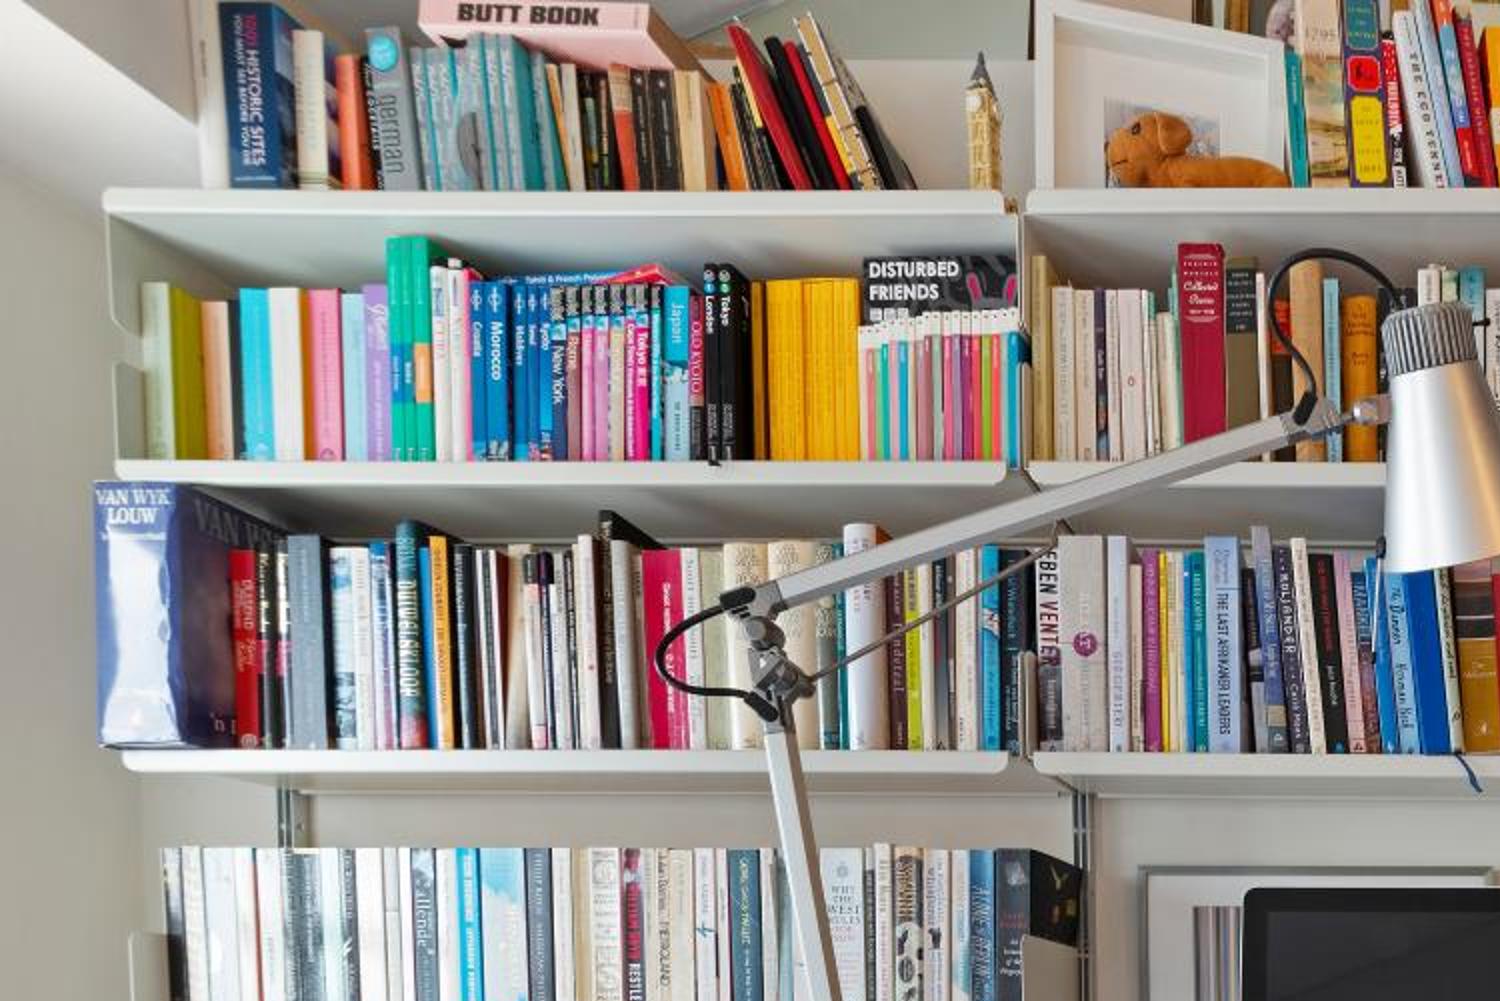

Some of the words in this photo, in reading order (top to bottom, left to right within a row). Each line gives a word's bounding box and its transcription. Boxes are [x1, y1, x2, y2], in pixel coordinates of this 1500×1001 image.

[233, 15, 243, 35] YOU
[245, 15, 259, 46] 1001
[457, 4, 522, 22] BUTT
[530, 4, 599, 25] BOOK
[235, 38, 245, 65] MUST
[237, 69, 247, 86] SEE
[245, 50, 264, 123] HISTORIC
[238, 87, 249, 122] BEFORE
[241, 127, 250, 145] YOU
[249, 125, 266, 167] SITES
[379, 95, 406, 174] german
[869, 261, 960, 279] DISTURBED
[869, 283, 940, 301] FRIENDS
[669, 302, 685, 344] Japan
[705, 296, 715, 334] London
[720, 296, 731, 326] Tokyo
[472, 321, 483, 357] Croatia
[490, 321, 503, 381] Morocco
[515, 325, 524, 366] Maldives
[540, 323, 550, 351] Kyoto
[636, 332, 647, 365] Tokyo
[690, 321, 703, 349] OLD
[553, 346, 565, 375] New
[568, 336, 579, 370] Rome
[690, 351, 702, 393] KYOTO
[552, 377, 565, 405] York
[96, 489, 129, 505] VAN
[132, 489, 171, 505] WYK
[107, 507, 158, 524] LOUW
[1040, 551, 1059, 594] EBEN
[1217, 592, 1231, 610] THE
[397, 579, 421, 698] DUIWELSKLOOF
[1040, 600, 1060, 668] VENTER
[1217, 612, 1231, 636] LAST
[1217, 639, 1232, 691] AFRIKANER
[1218, 693, 1232, 735] LEADERS
[415, 891, 431, 948] allende
[659, 920, 671, 986] METROLAND
